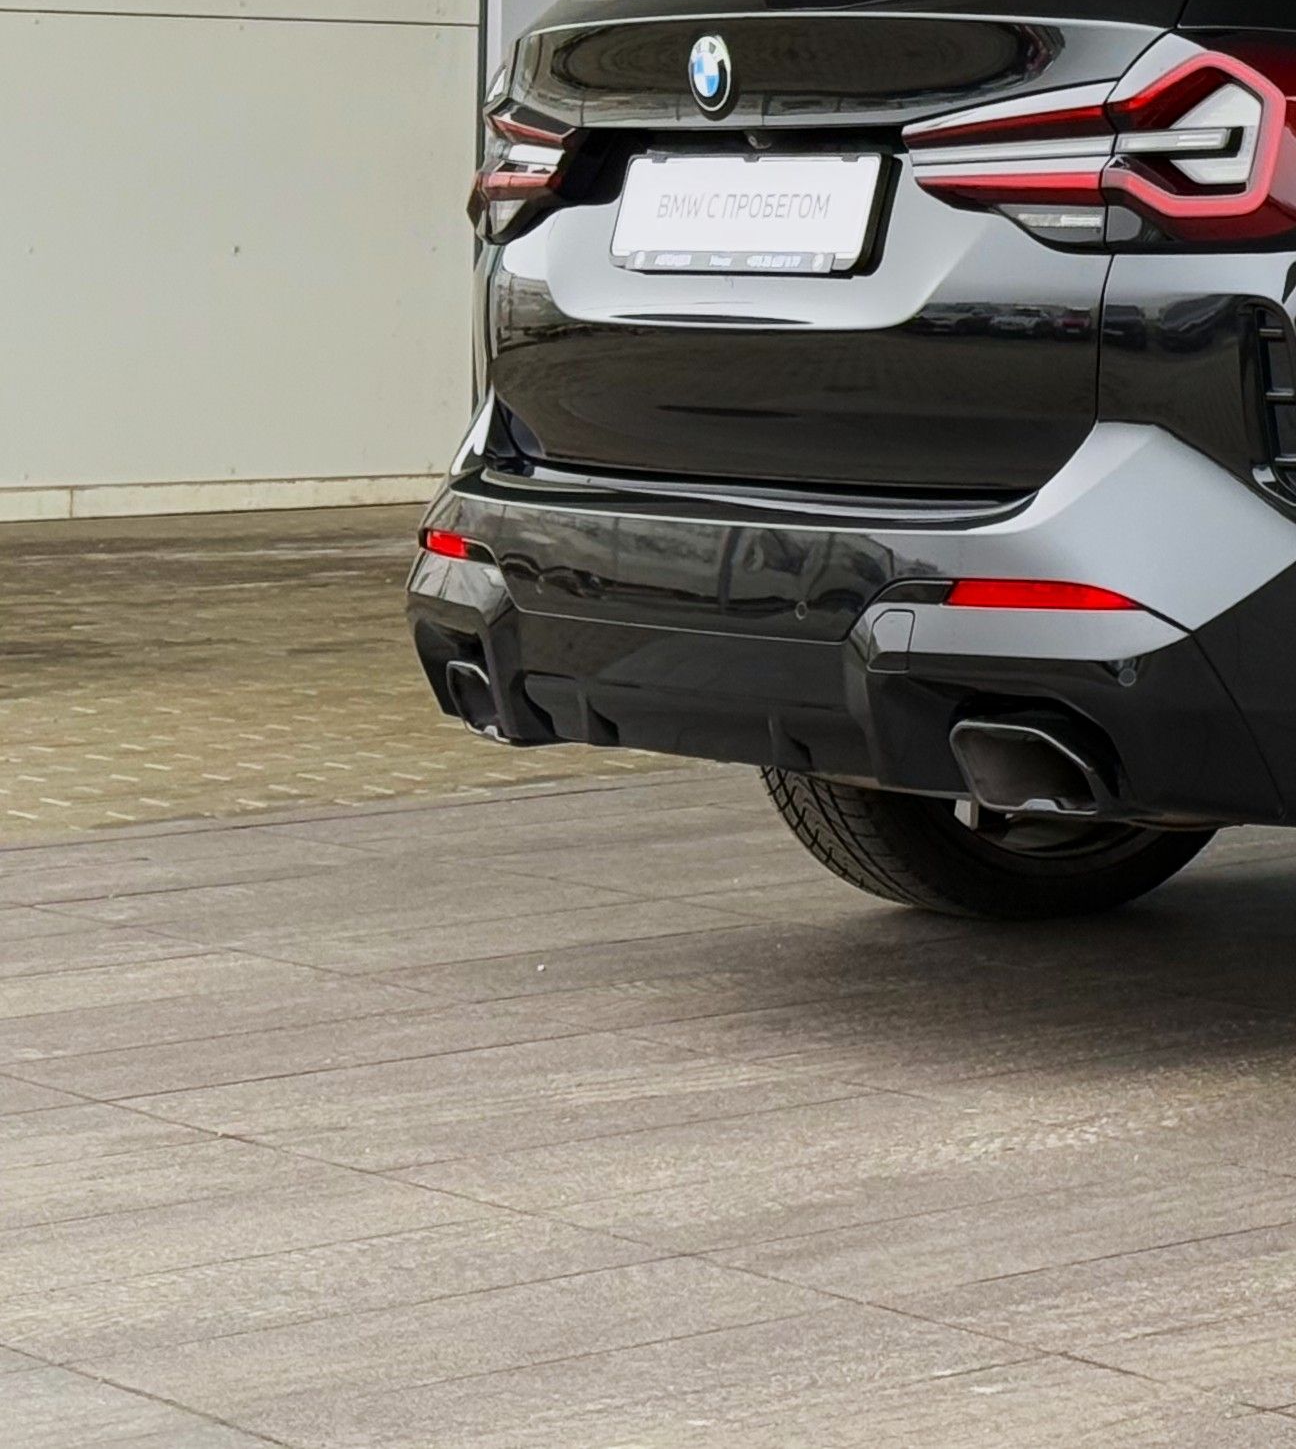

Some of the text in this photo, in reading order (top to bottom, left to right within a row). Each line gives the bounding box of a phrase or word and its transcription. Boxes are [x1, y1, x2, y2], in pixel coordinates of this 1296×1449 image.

[656, 193, 831, 219] BMW С ПРОБЕГОМ
